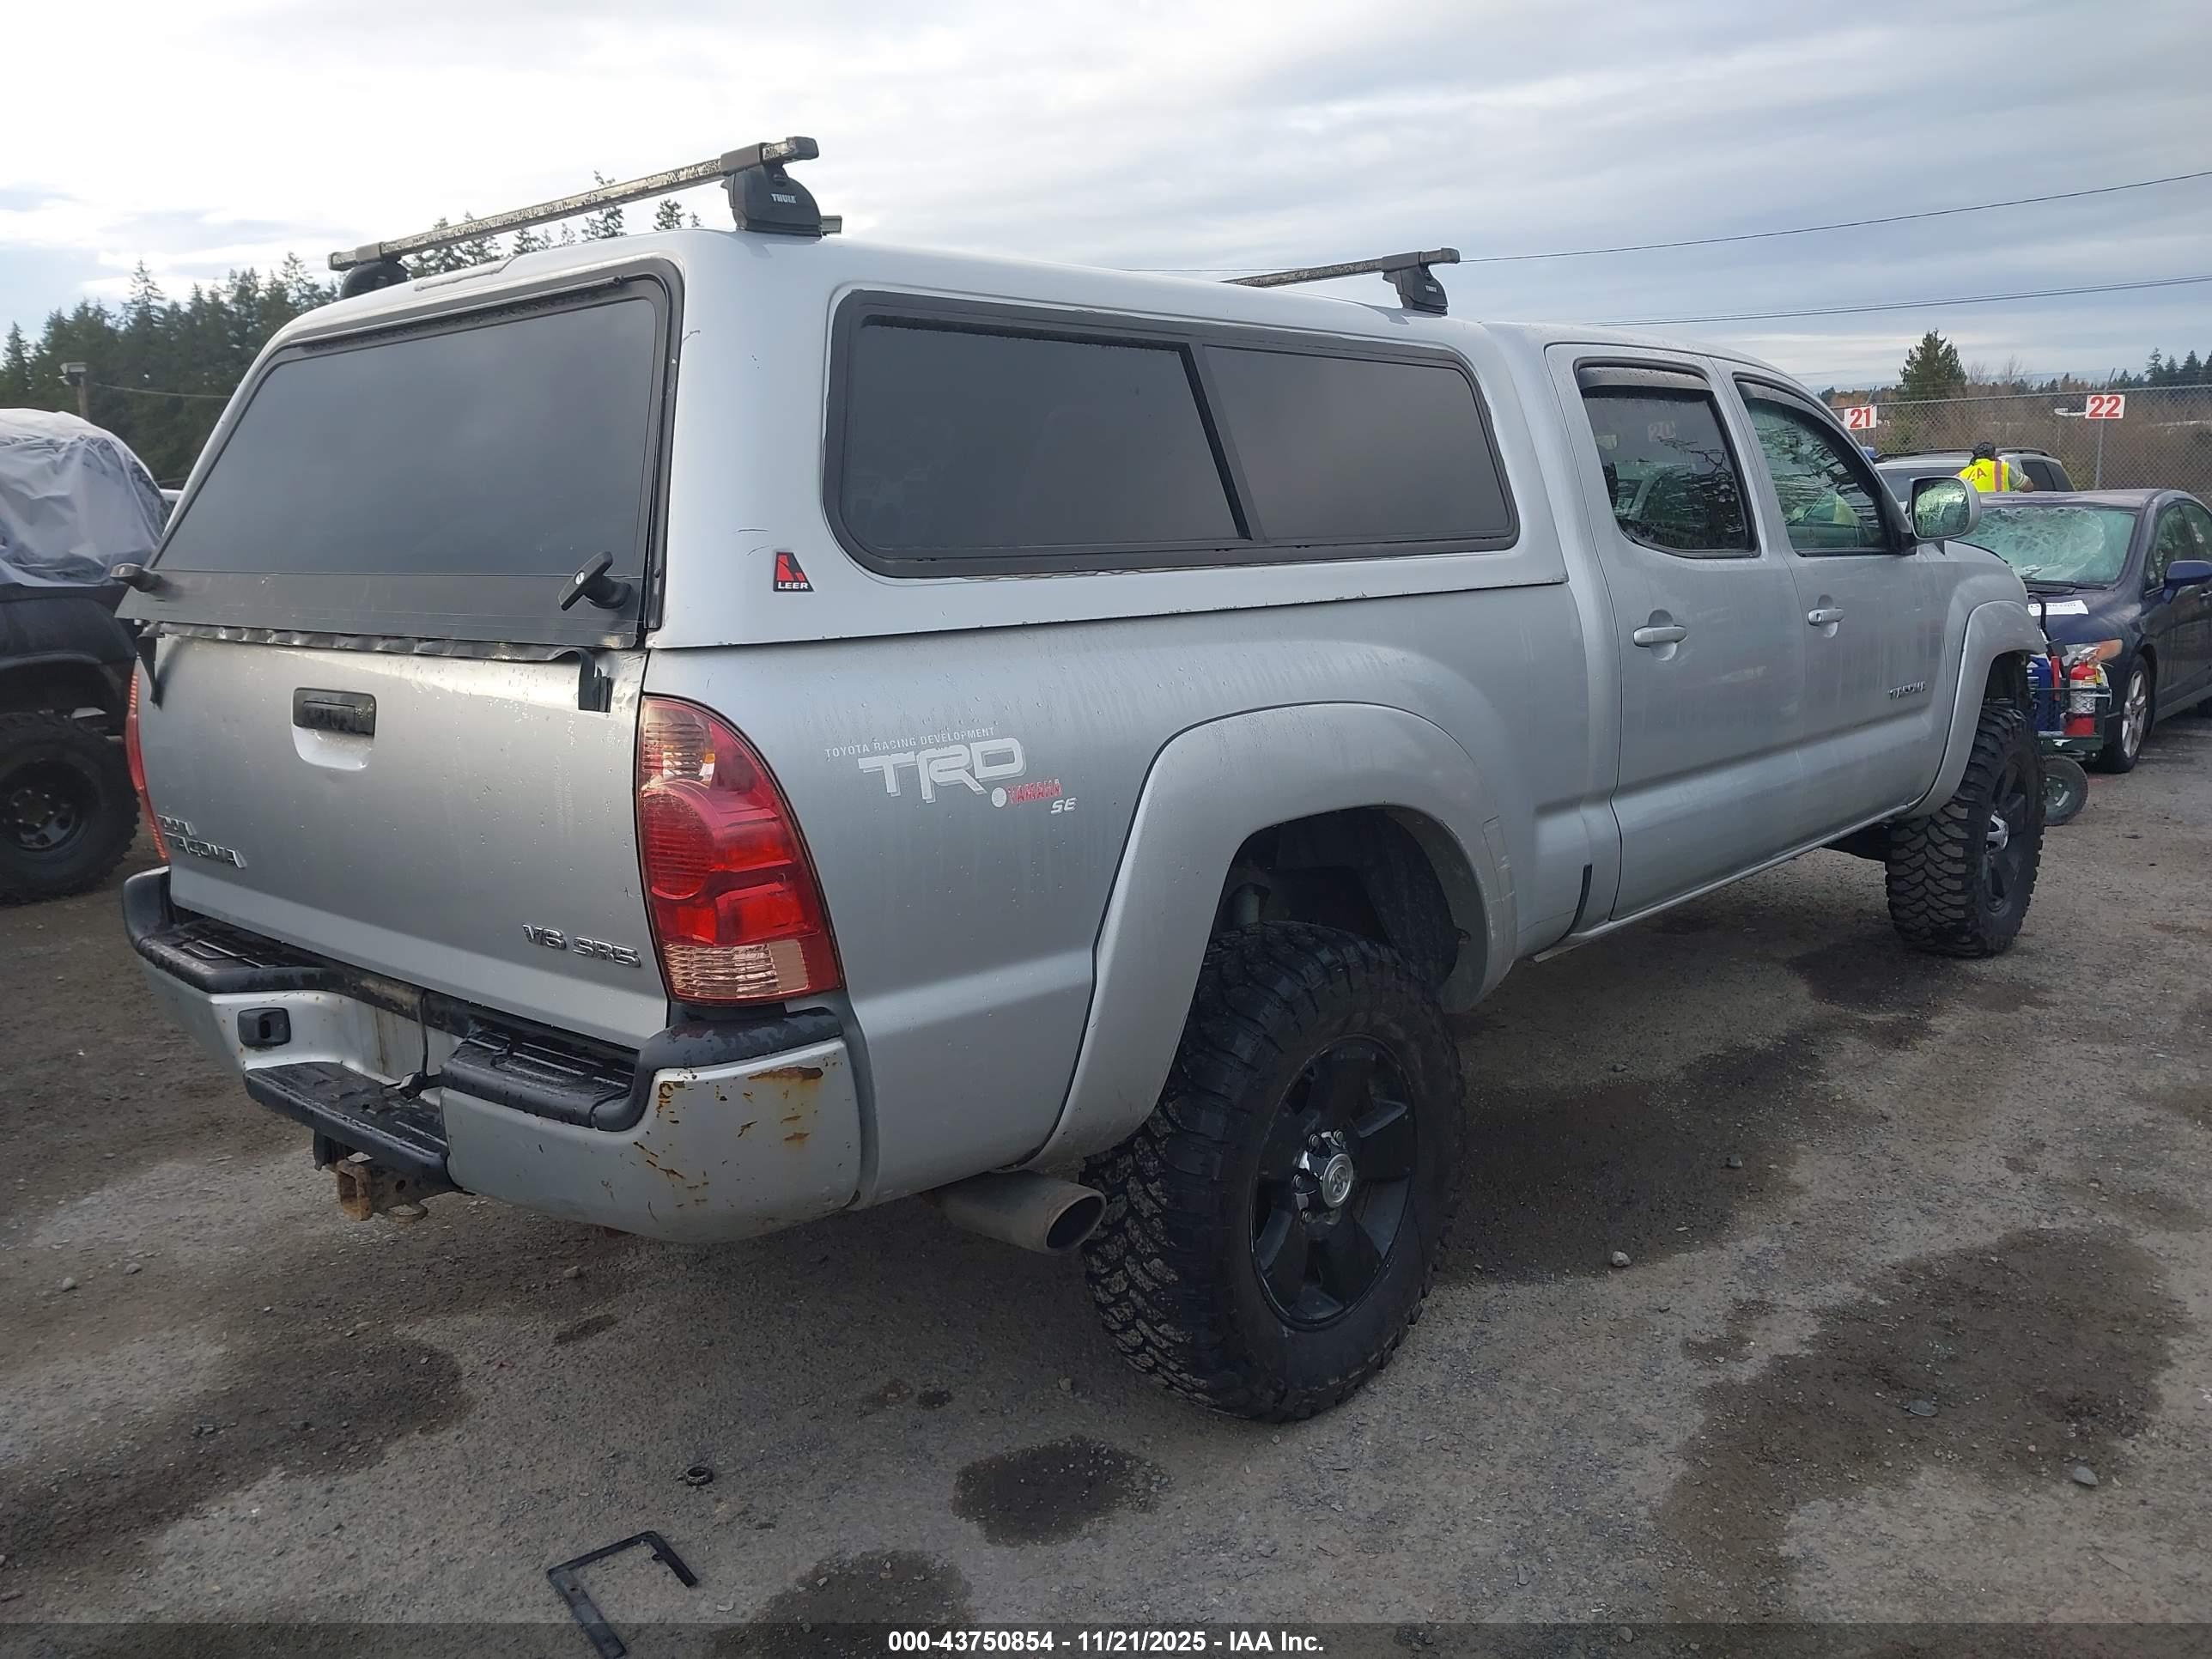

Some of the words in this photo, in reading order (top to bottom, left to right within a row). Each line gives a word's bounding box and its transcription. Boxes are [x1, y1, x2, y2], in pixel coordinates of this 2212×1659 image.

[771, 193, 797, 204] THULE
[2088, 396, 2121, 417] 22
[1850, 408, 1870, 428] 21
[777, 581, 809, 590] LEER
[824, 744, 870, 758] TOYOTA
[874, 737, 916, 751] RACING
[921, 726, 994, 744] DEVELOPMENT
[858, 738, 1025, 803] TRD
[1050, 797, 1078, 815] SE
[522, 923, 567, 951] V6
[573, 936, 641, 968] SR5
